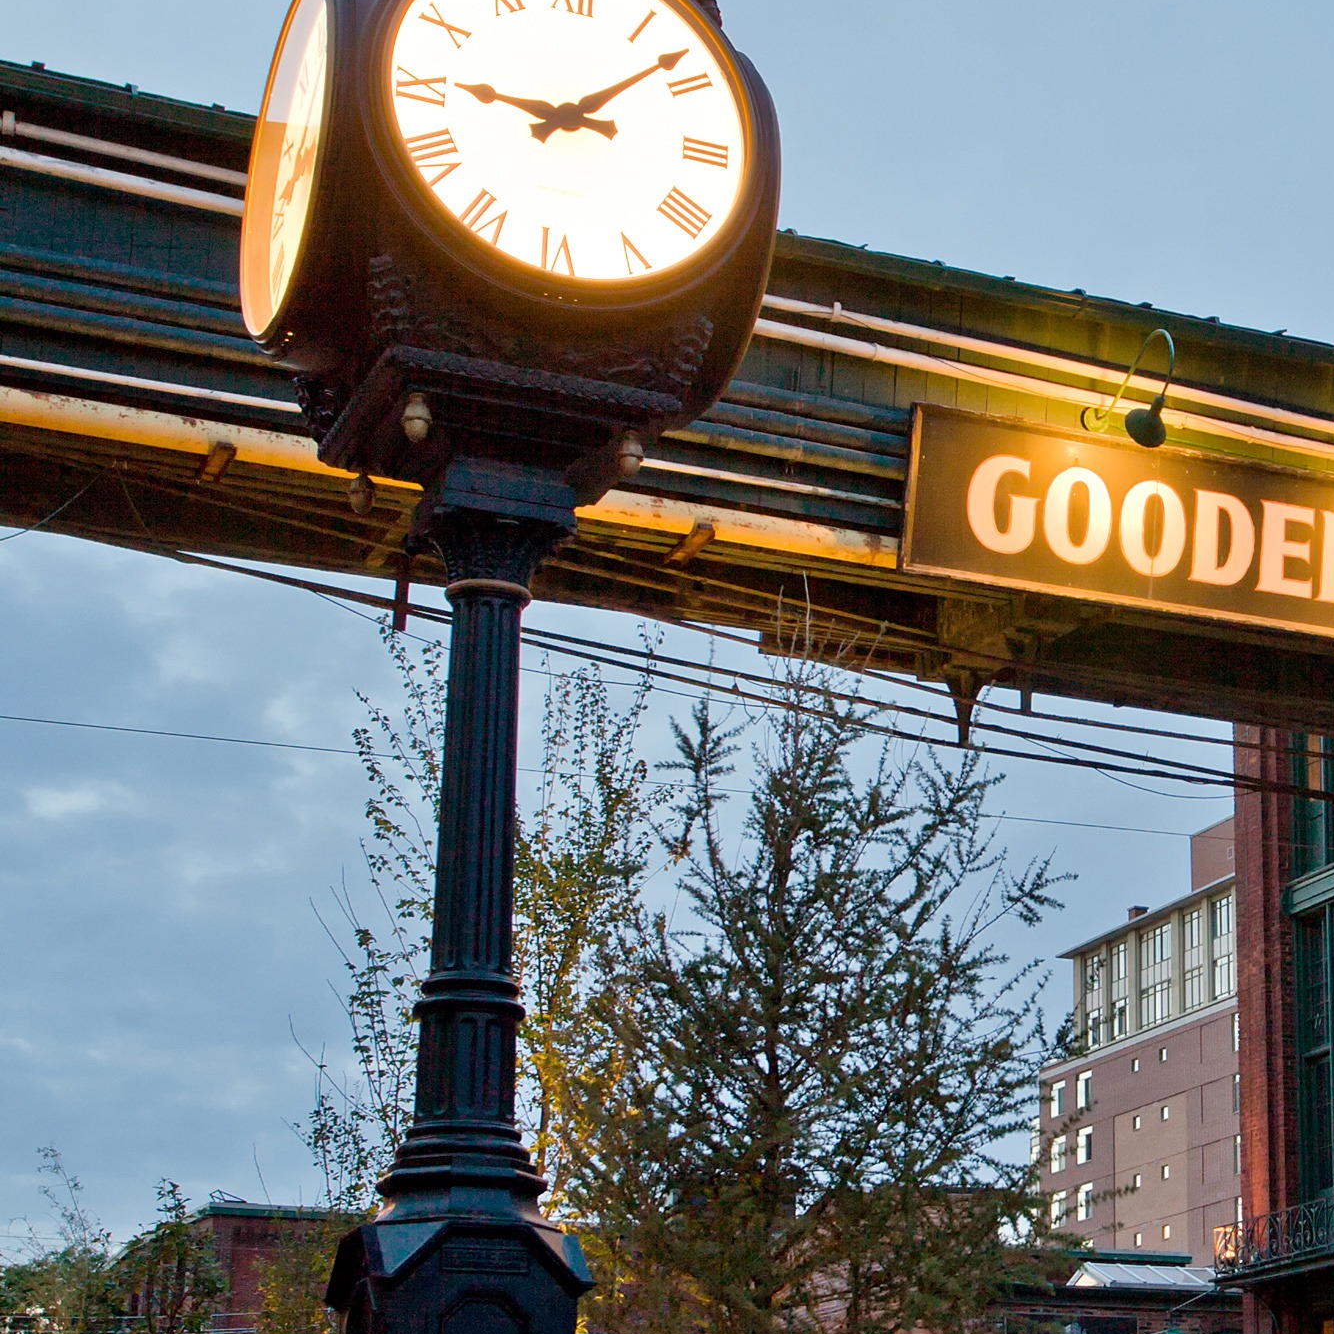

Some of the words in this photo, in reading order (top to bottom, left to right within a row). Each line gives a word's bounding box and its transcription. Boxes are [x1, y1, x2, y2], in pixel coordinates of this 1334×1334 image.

[418, 3, 472, 49] X
[627, 9, 657, 43] I
[667, 72, 714, 97] II
[682, 135, 729, 169] III
[656, 186, 713, 240] IIII
[621, 231, 653, 275] V
